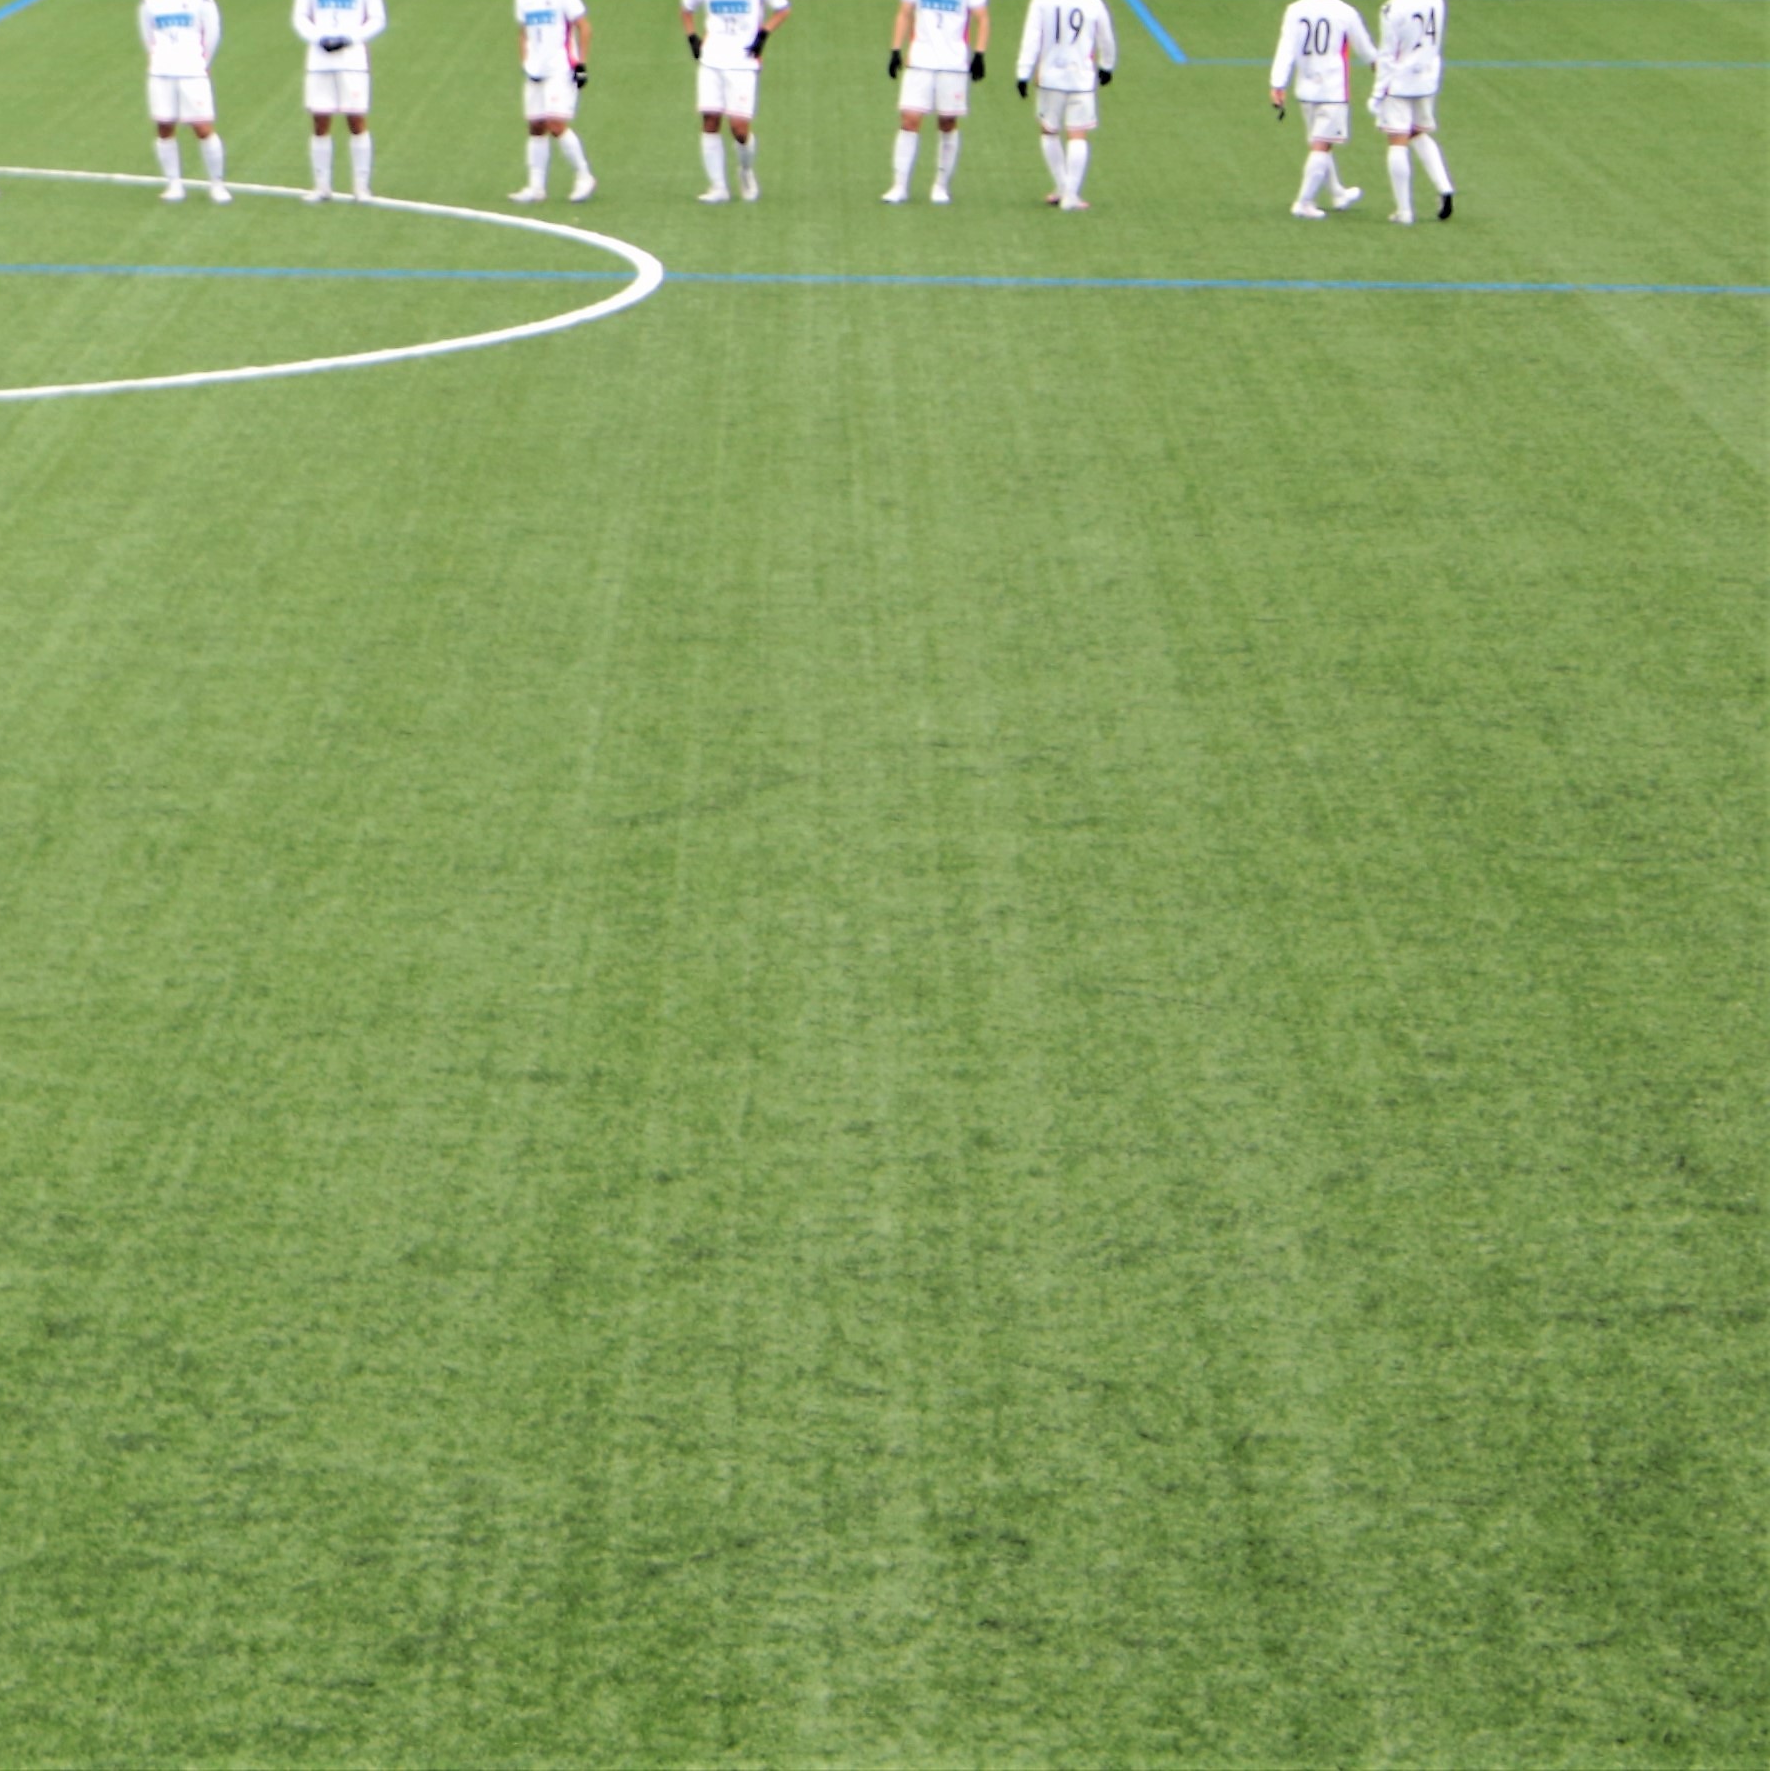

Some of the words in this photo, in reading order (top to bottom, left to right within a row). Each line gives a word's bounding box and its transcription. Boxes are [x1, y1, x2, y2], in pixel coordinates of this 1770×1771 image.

[1054, 6, 1084, 45] 19
[1299, 17, 1330, 56] 20
[1412, 7, 1436, 51] 24
